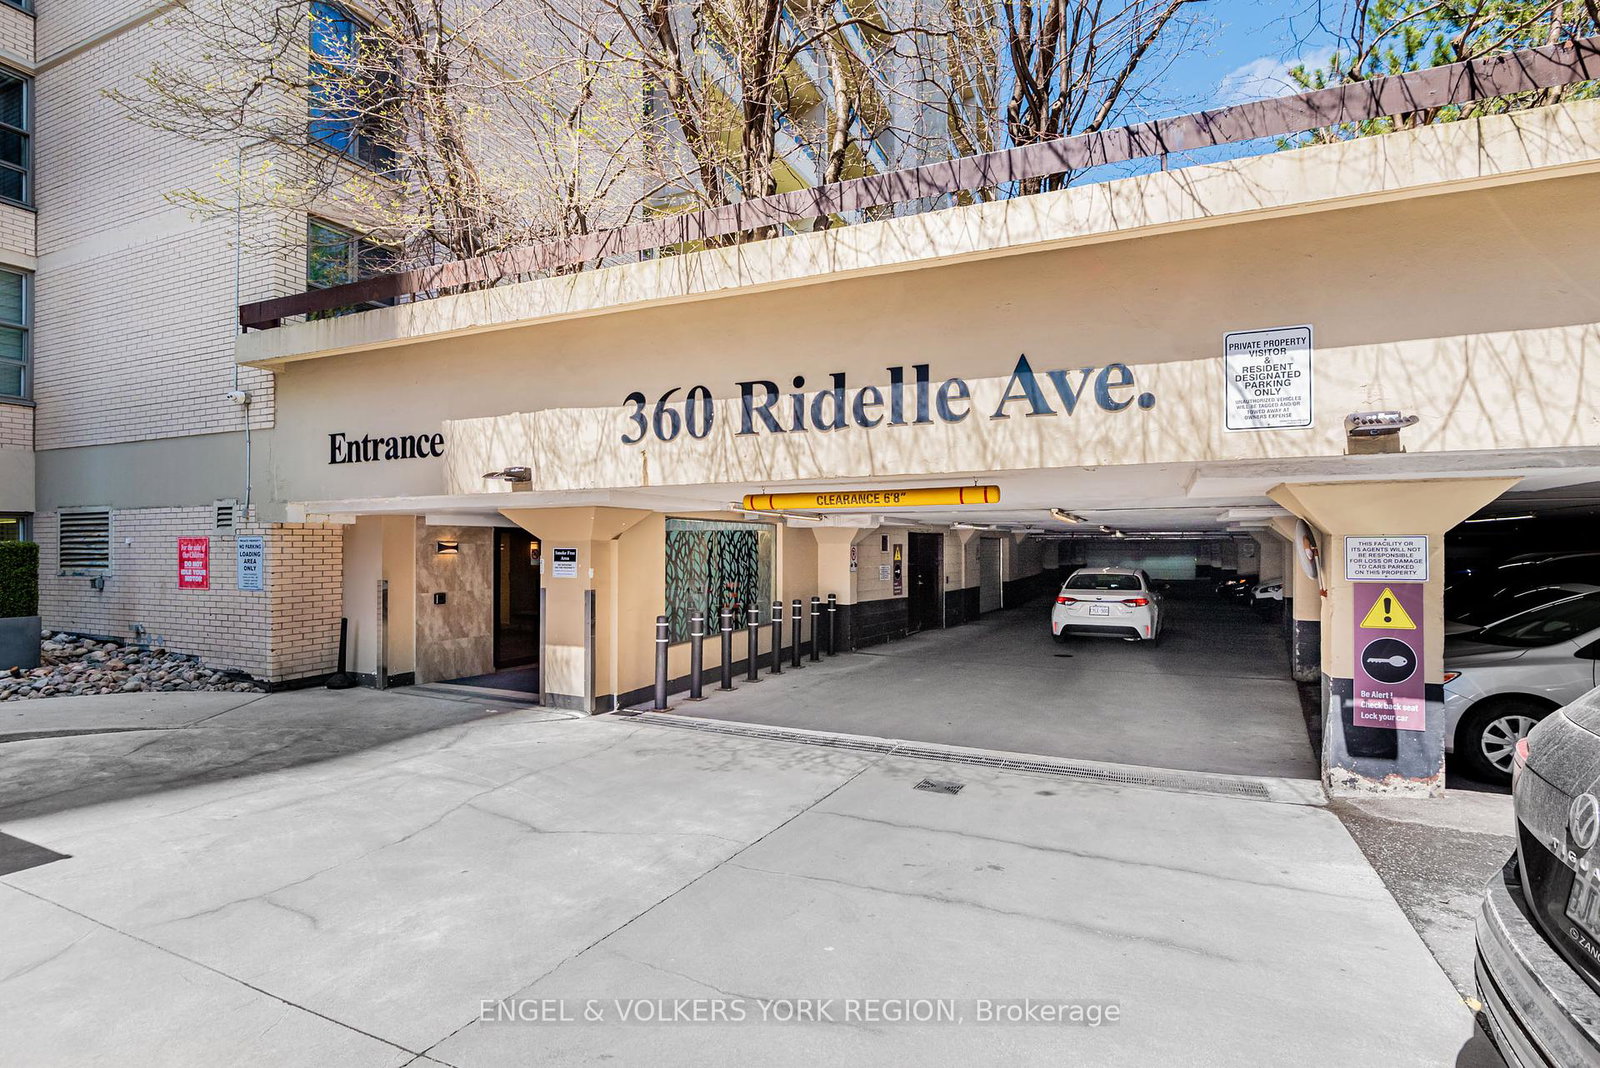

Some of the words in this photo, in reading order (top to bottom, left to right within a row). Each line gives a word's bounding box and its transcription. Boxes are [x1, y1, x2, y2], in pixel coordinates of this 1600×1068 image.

[1229, 341, 1261, 351] PRIVATE
[1264, 337, 1306, 348] PROPERTY
[1249, 347, 1287, 357] VISITOR
[1242, 363, 1294, 374] RESIDENT
[1235, 370, 1301, 382] DESIGNATED
[1245, 379, 1291, 389] PARKING
[1254, 388, 1281, 396] ONLY
[621, 384, 714, 446] 360
[734, 363, 971, 439] Ridelle
[990, 353, 1157, 421] Ave.
[328, 432, 445, 465] Entrance
[816, 493, 880, 506] CLEARANCE
[884, 492, 907, 504] 6'8"
[1360, 701, 1383, 709] Check
[1383, 702, 1401, 710] back
[1402, 704, 1419, 712] seat
